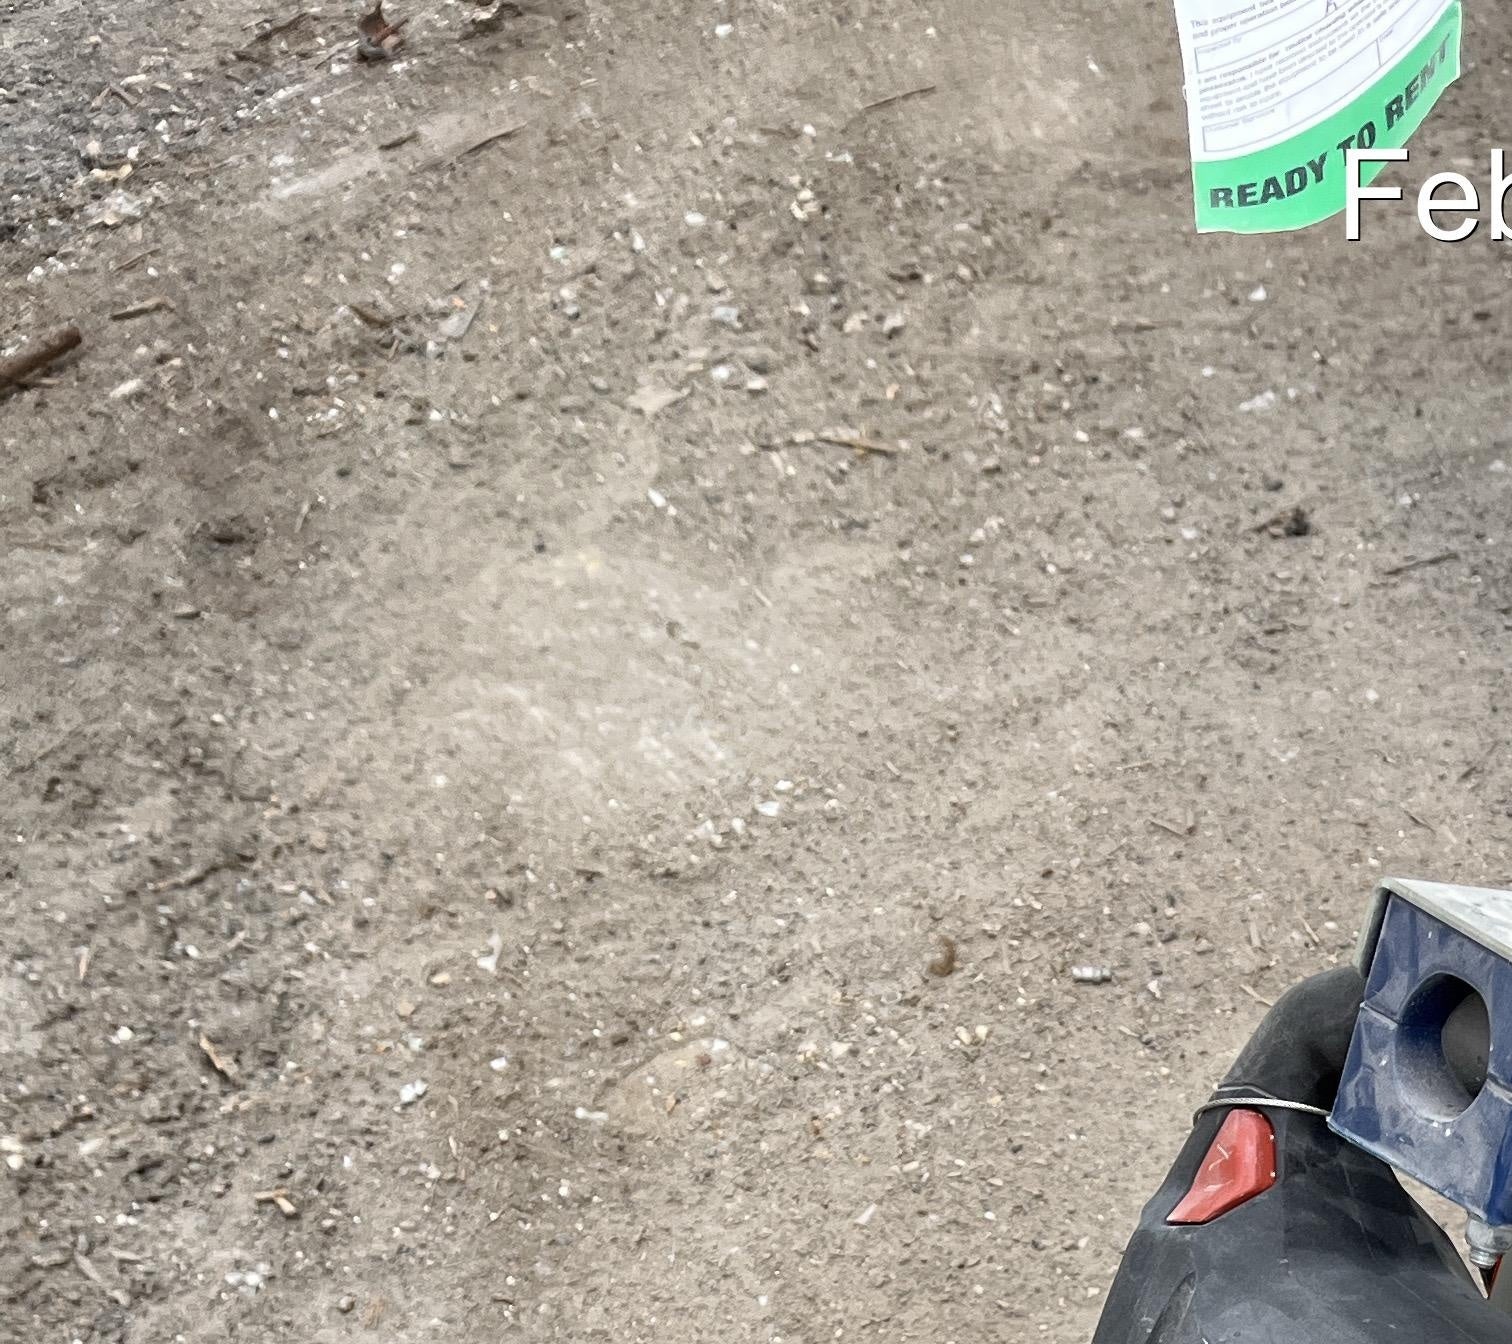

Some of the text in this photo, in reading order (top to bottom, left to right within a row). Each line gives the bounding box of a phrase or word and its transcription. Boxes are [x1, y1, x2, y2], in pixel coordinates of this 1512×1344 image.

[1210, 151, 1328, 208] READY
[1336, 121, 1376, 167] TO
[1384, 33, 1451, 131] RENT
